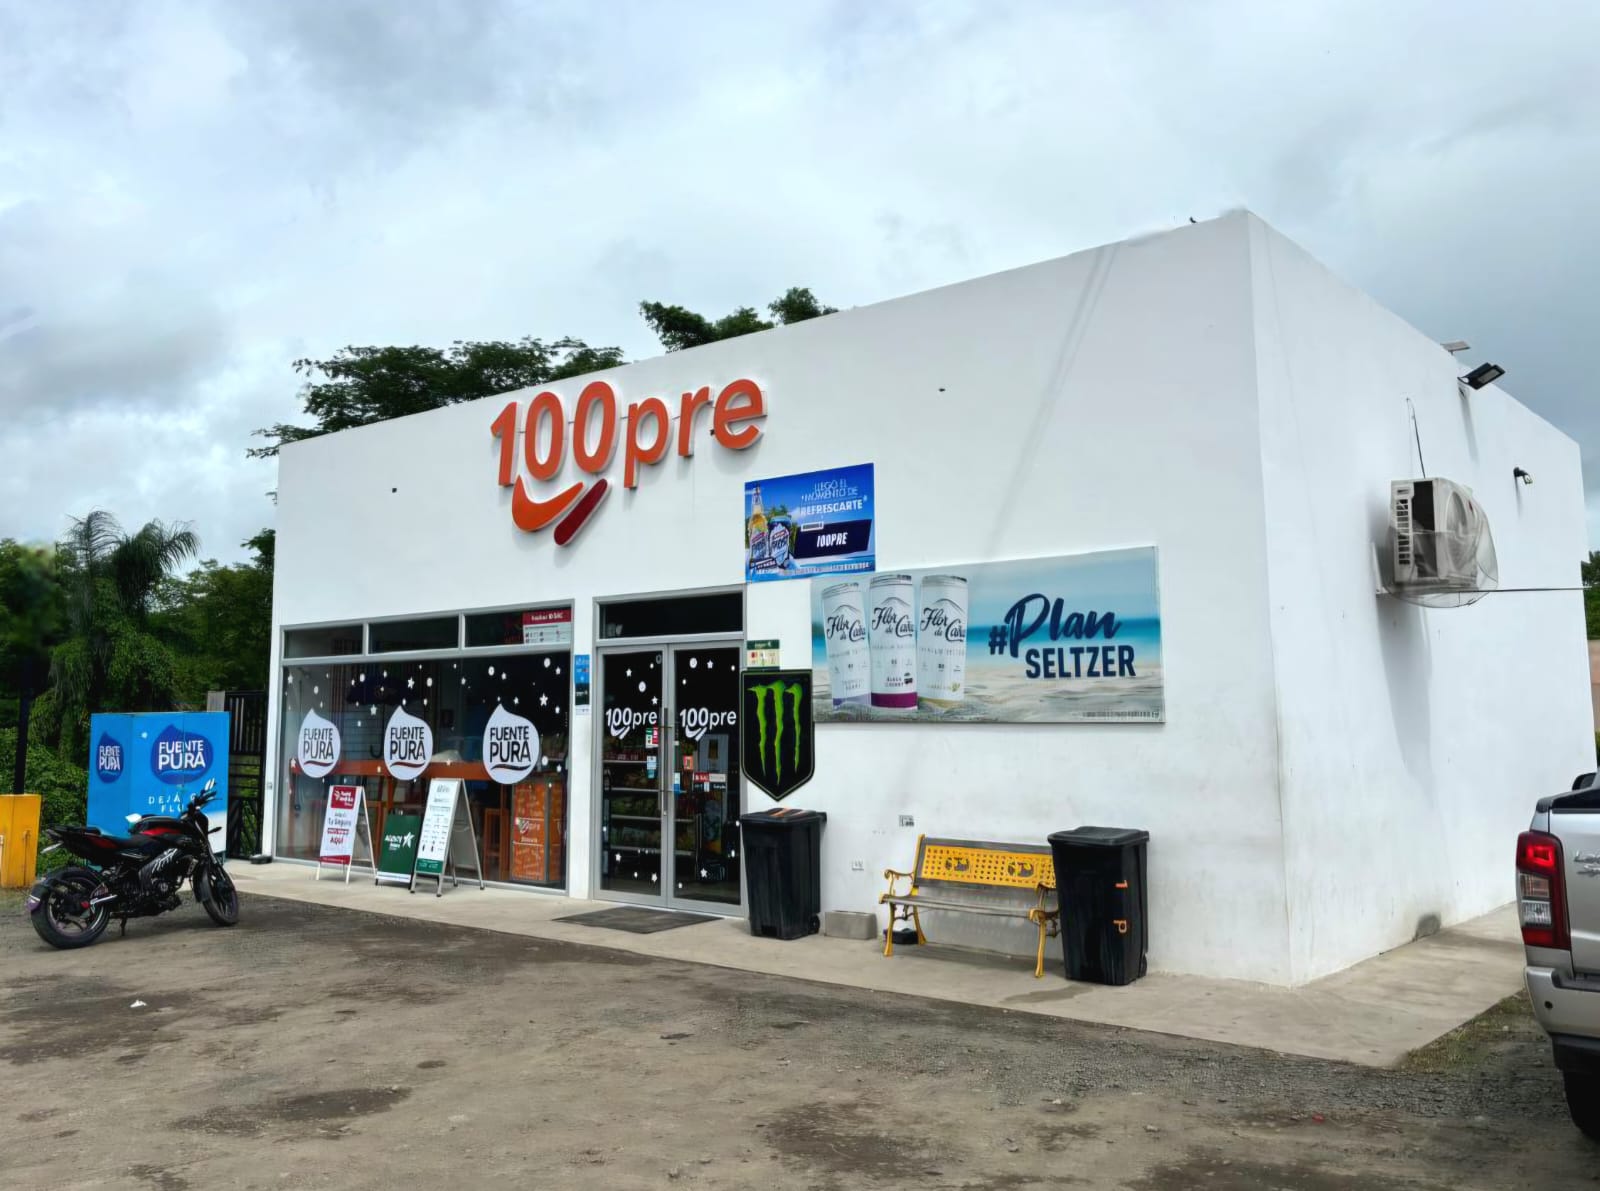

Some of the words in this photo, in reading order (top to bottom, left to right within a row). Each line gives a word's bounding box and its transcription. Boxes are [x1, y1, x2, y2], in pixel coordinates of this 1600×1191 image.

[490, 378, 765, 489] 100pre
[800, 499, 863, 516] REFRESCARTE
[988, 593, 1122, 658] #Plan
[1025, 645, 1136, 679] SELTZER
[605, 707, 658, 730] 100pre
[680, 707, 737, 731] 100pre
[303, 728, 333, 741] FUENTE
[390, 726, 425, 741] FUENTE
[489, 725, 530, 741] FUENTE
[99, 745, 120, 757] FUENTE
[159, 740, 204, 754] FUENTE
[303, 740, 334, 760] PURA
[389, 739, 426, 761] PURA
[489, 740, 532, 763] PURA
[99, 756, 121, 770] PURA
[158, 752, 206, 770] PURA
